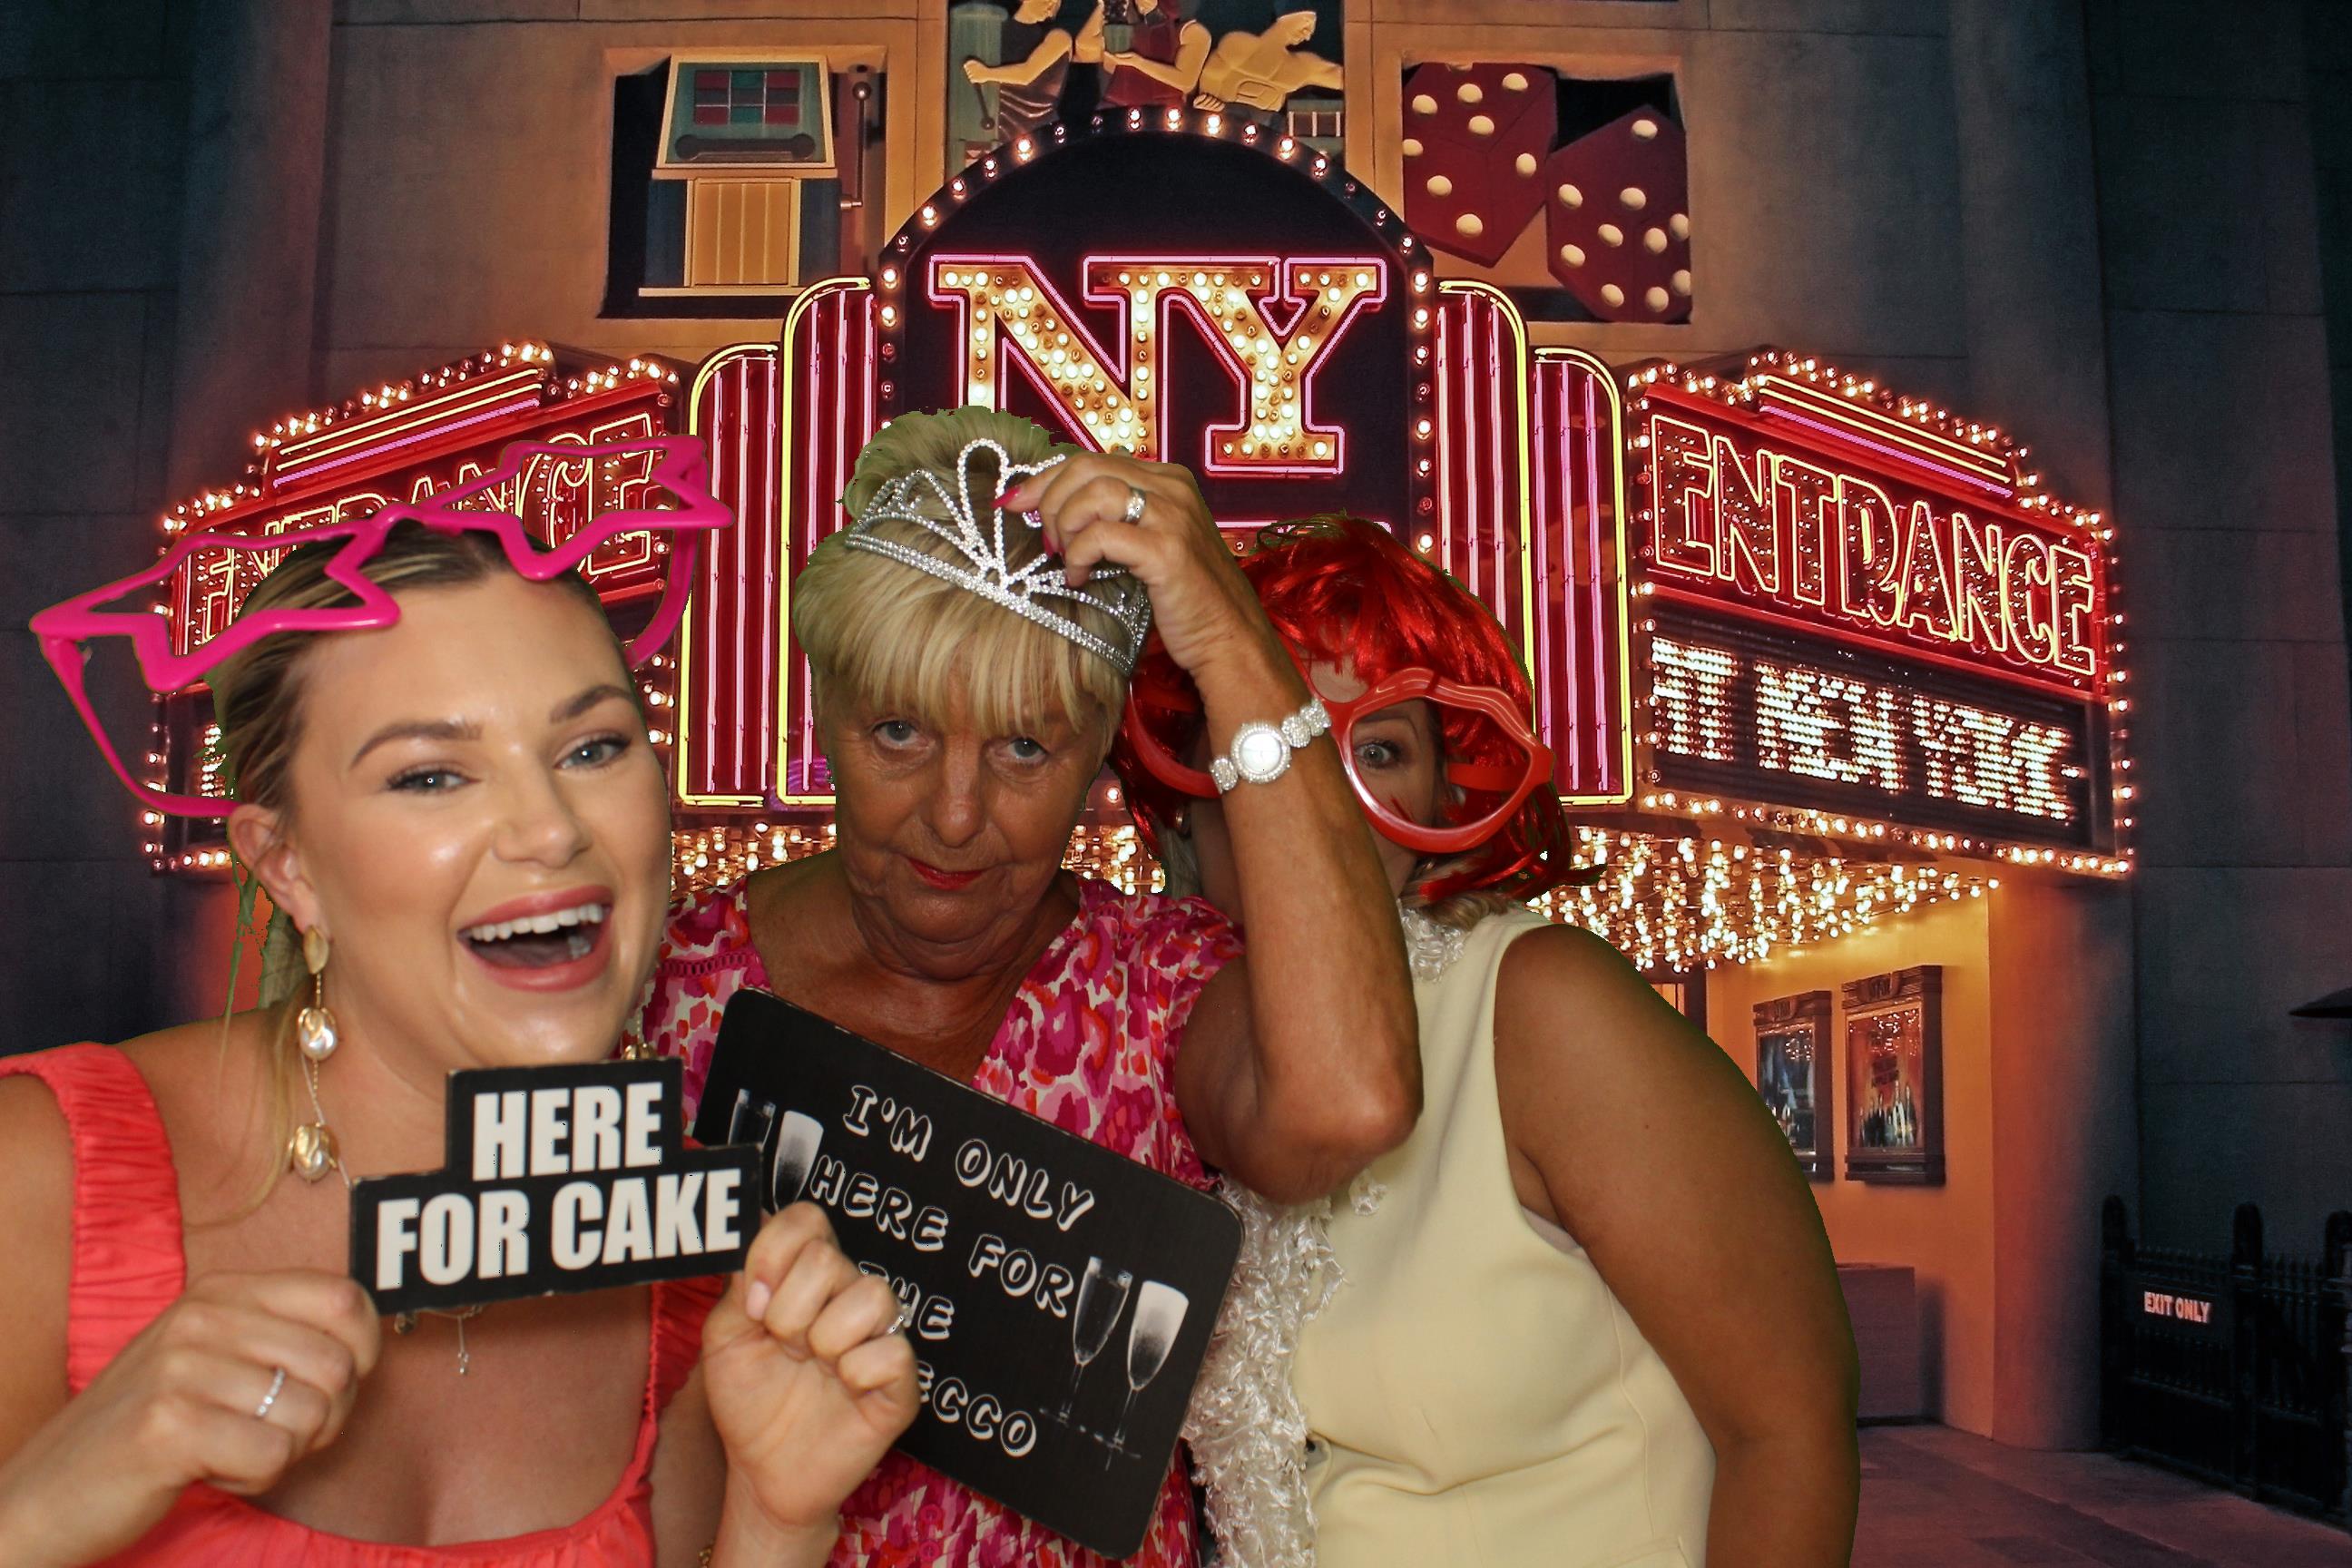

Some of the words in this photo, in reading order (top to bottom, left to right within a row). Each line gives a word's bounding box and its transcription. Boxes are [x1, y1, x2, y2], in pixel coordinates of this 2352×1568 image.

[928, 255, 1387, 475] NY
[1651, 414, 2097, 676] ENTRANCE
[473, 1082, 662, 1181] HERE
[843, 1084, 933, 1162] I'M
[955, 1138, 1095, 1231] ONLY
[377, 1190, 530, 1290] FOR
[551, 1169, 741, 1270] CAKE
[810, 1154, 949, 1251] HERE
[968, 1233, 1074, 1318] FOR
[2144, 1290, 2173, 1316] EXIT
[2175, 1297, 2211, 1323] ONLY
